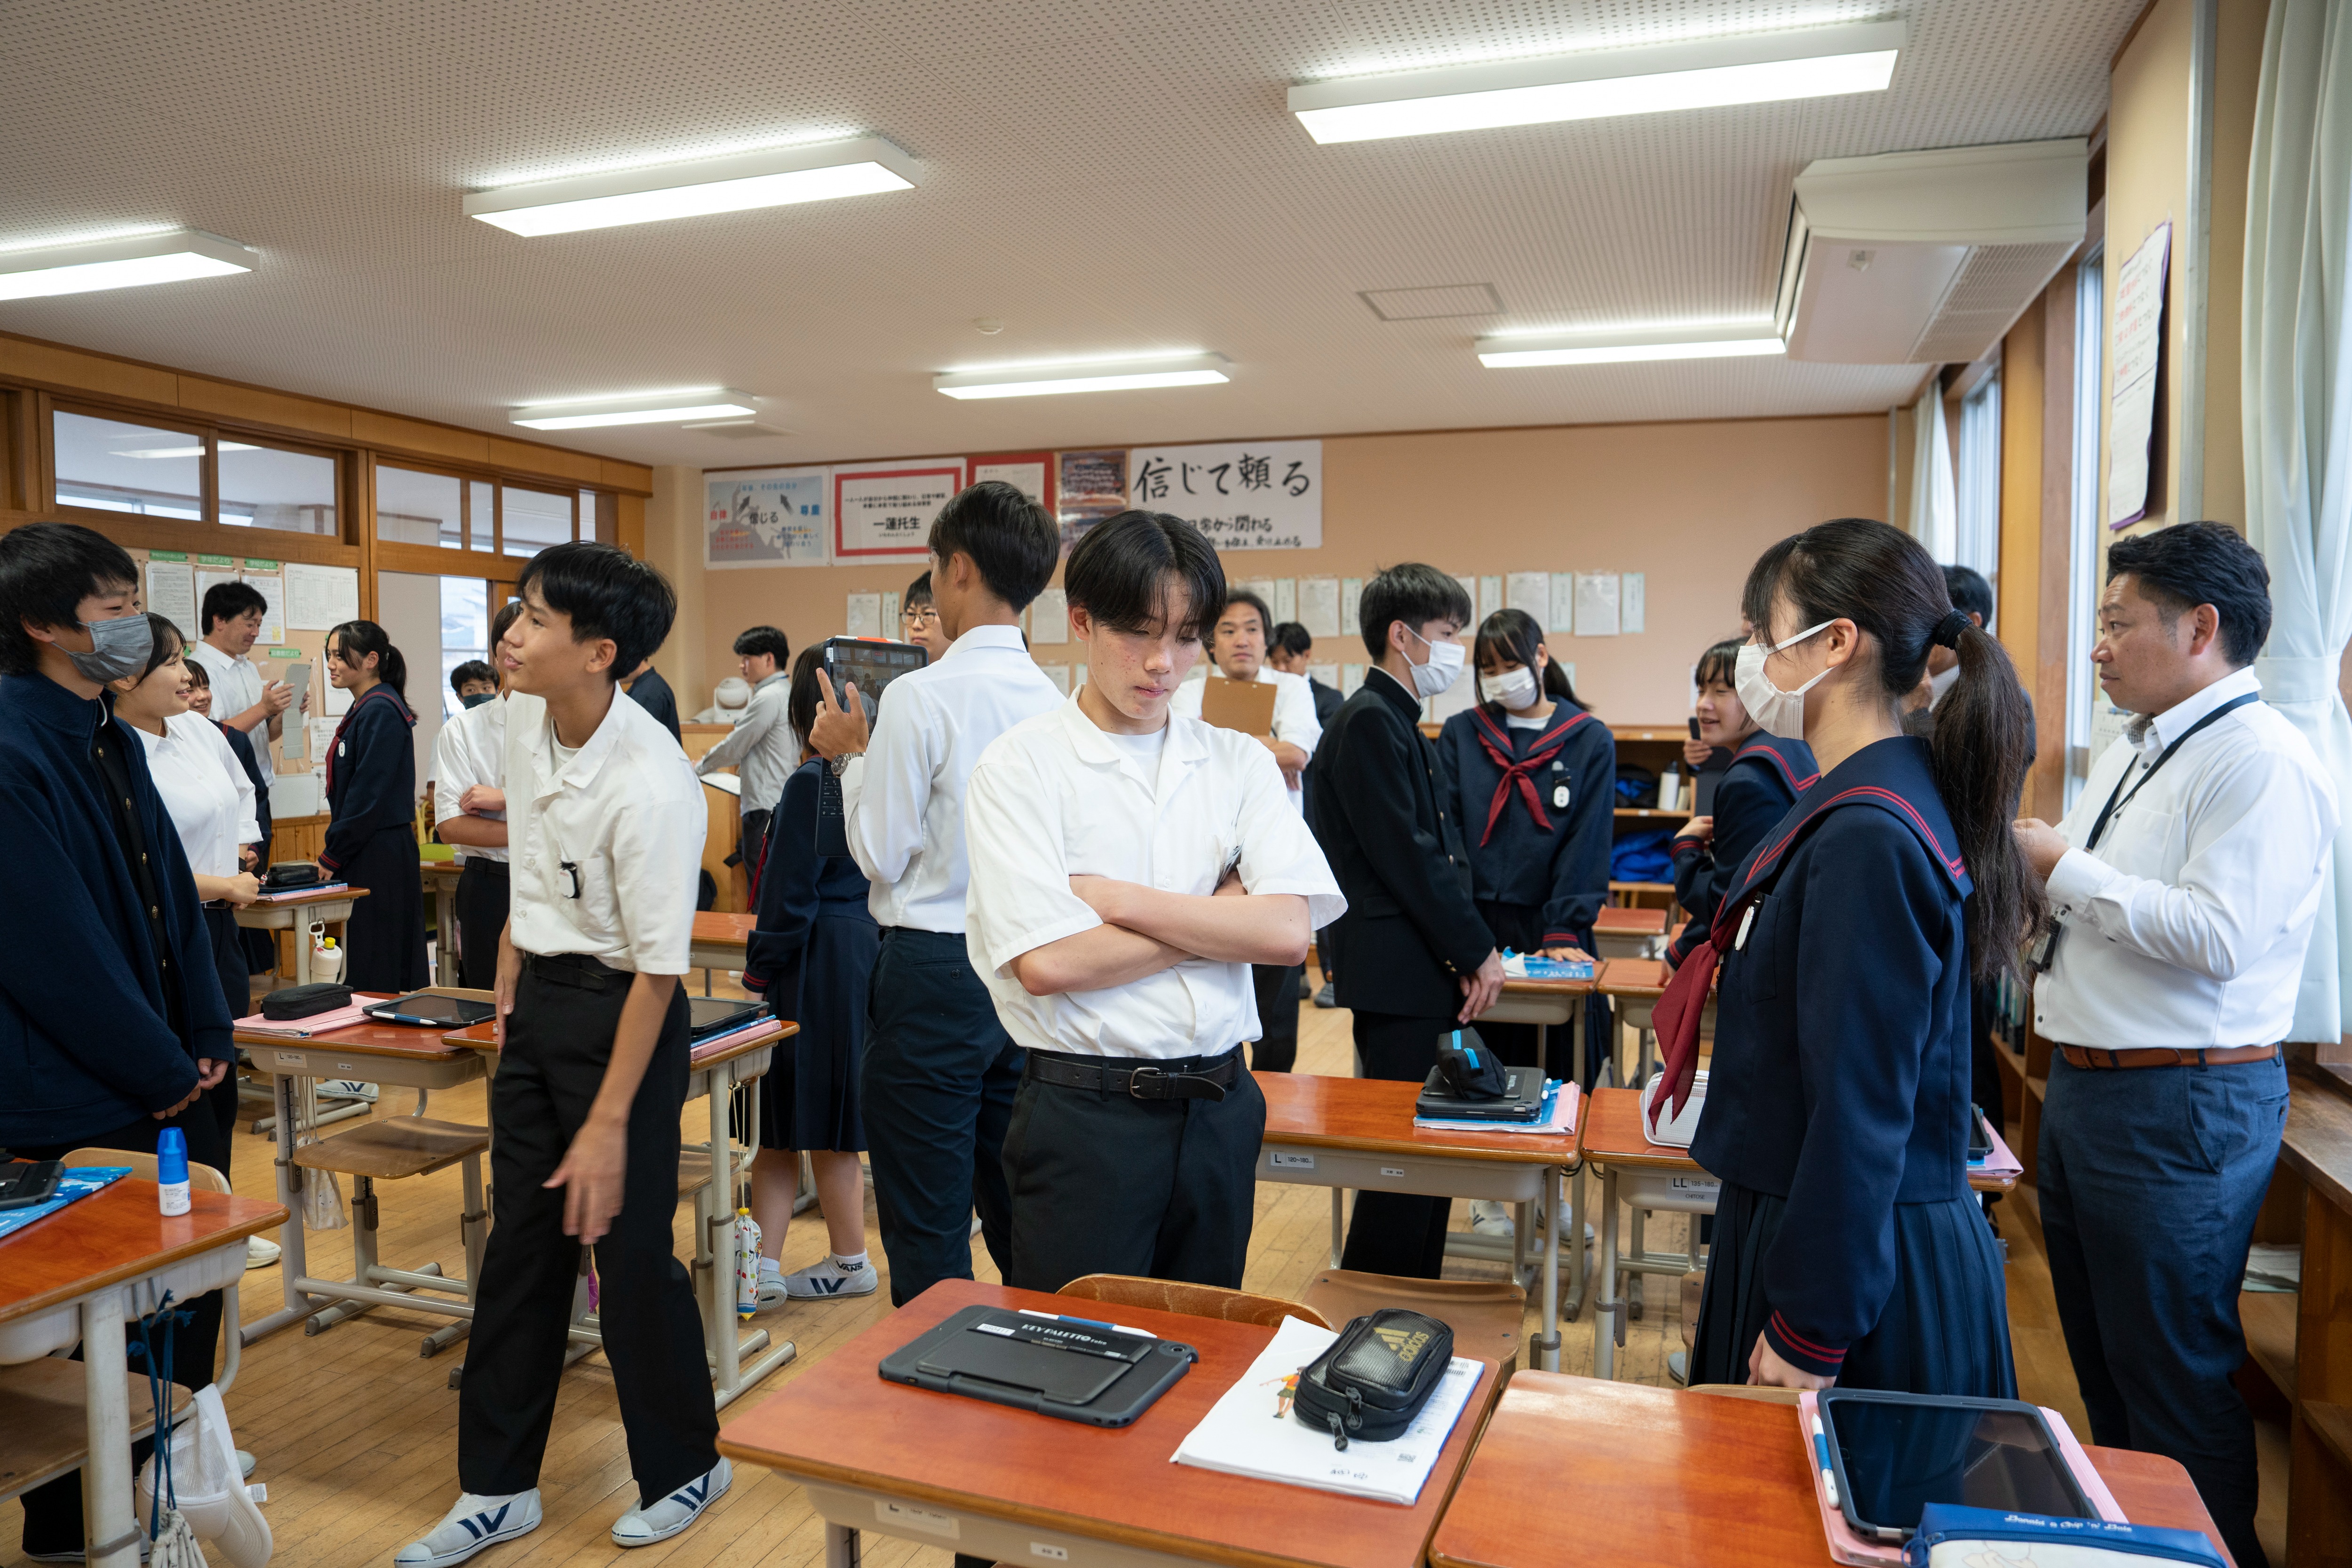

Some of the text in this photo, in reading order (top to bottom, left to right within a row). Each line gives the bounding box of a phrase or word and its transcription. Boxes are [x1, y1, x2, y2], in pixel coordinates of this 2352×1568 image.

[1132, 453, 1310, 503] 信じて頼る
[749, 511, 779, 525] 信じる
[873, 516, 921, 530] 一蓮托生
[1274, 1154, 1282, 1163] L
[1673, 1177, 1687, 1188] LL
[836, 1260, 863, 1272] VANS
[1021, 1323, 1045, 1333] KEY
[1043, 1328, 1091, 1342] PALETTO
[1398, 1331, 1430, 1362] adidas
[2004, 1514, 2045, 1527] Donald
[2059, 1520, 2084, 1529] Chip
